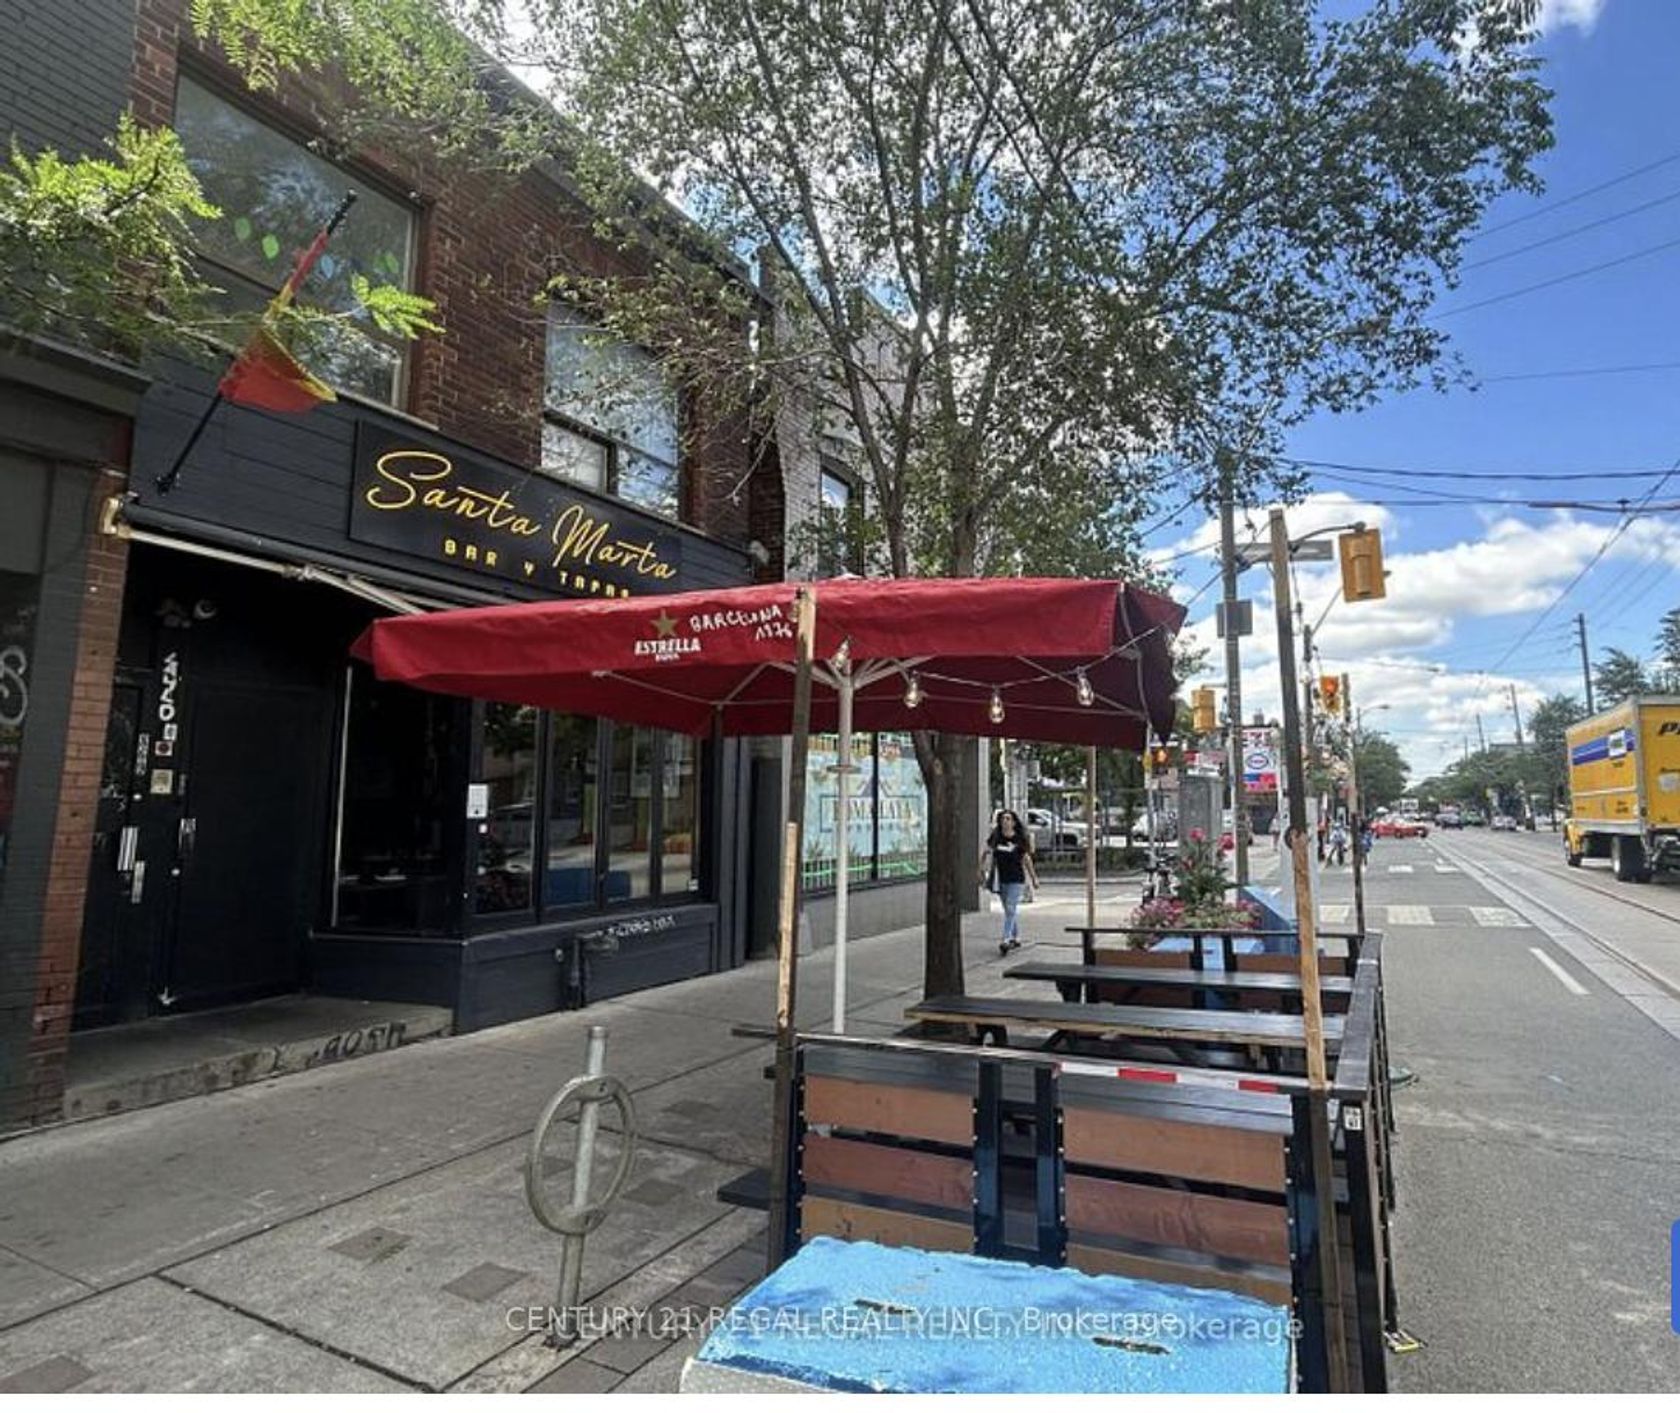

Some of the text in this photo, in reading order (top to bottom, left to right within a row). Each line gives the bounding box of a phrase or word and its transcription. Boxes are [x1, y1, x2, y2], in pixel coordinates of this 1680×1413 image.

[367, 450, 677, 580] Santa Marta
[444, 538, 498, 568] BAR
[634, 637, 702, 656] ESTRELLA
